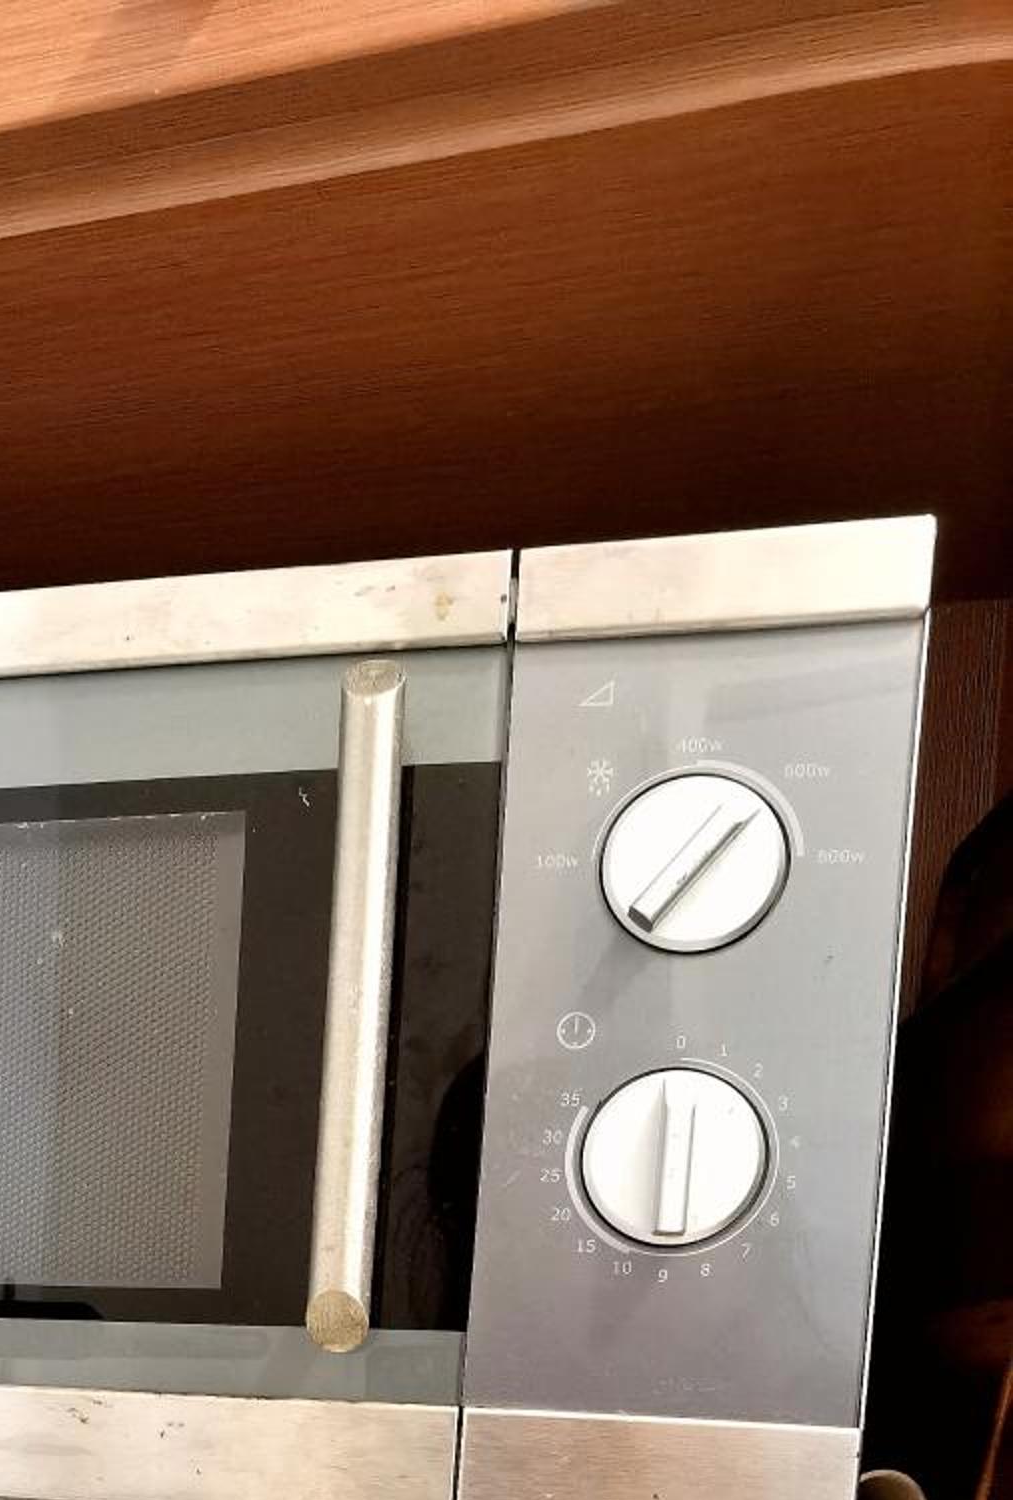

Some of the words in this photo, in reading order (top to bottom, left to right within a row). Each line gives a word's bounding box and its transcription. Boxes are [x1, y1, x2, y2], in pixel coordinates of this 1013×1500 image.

[720, 1043, 728, 1057] 1
[752, 1063, 763, 1078] 2
[561, 1093, 580, 1107] 35
[778, 1096, 788, 1110] 3
[542, 1130, 563, 1144] 30
[540, 1168, 560, 1182] 25
[786, 1175, 796, 1190] 5
[551, 1207, 570, 1221] 20
[770, 1213, 779, 1226] 6
[577, 1239, 596, 1253] 15
[741, 1243, 752, 1258] 7
[613, 1261, 632, 1275] 10
[700, 1262, 711, 1277] 8
[658, 1269, 668, 1283] 9
